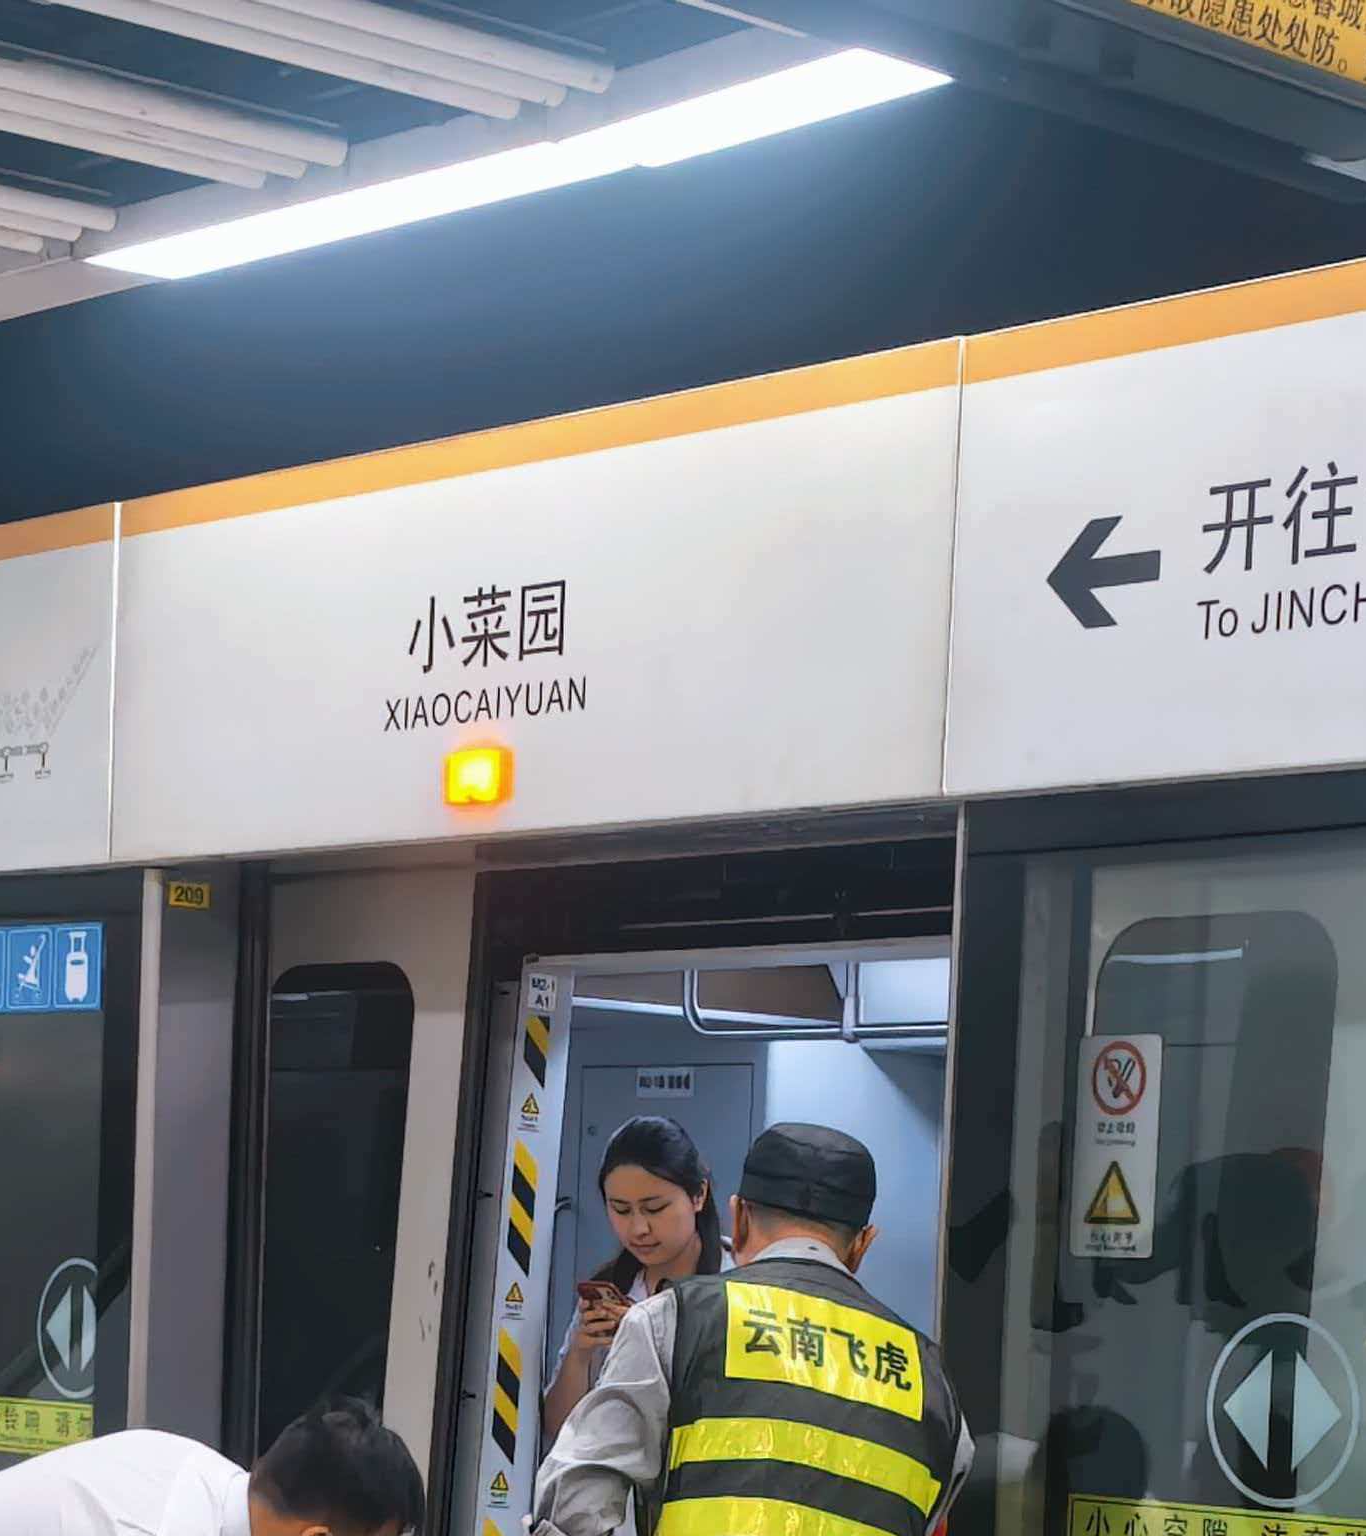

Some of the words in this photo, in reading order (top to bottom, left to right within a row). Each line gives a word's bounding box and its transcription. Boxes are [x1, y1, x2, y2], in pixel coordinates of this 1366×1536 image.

[408, 580, 567, 674] 小菜园
[1196, 600, 1239, 640] To
[384, 677, 588, 732] XIAOCAIYUAN
[173, 885, 205, 904] 209
[742, 1308, 913, 1392] 云南飞虎
